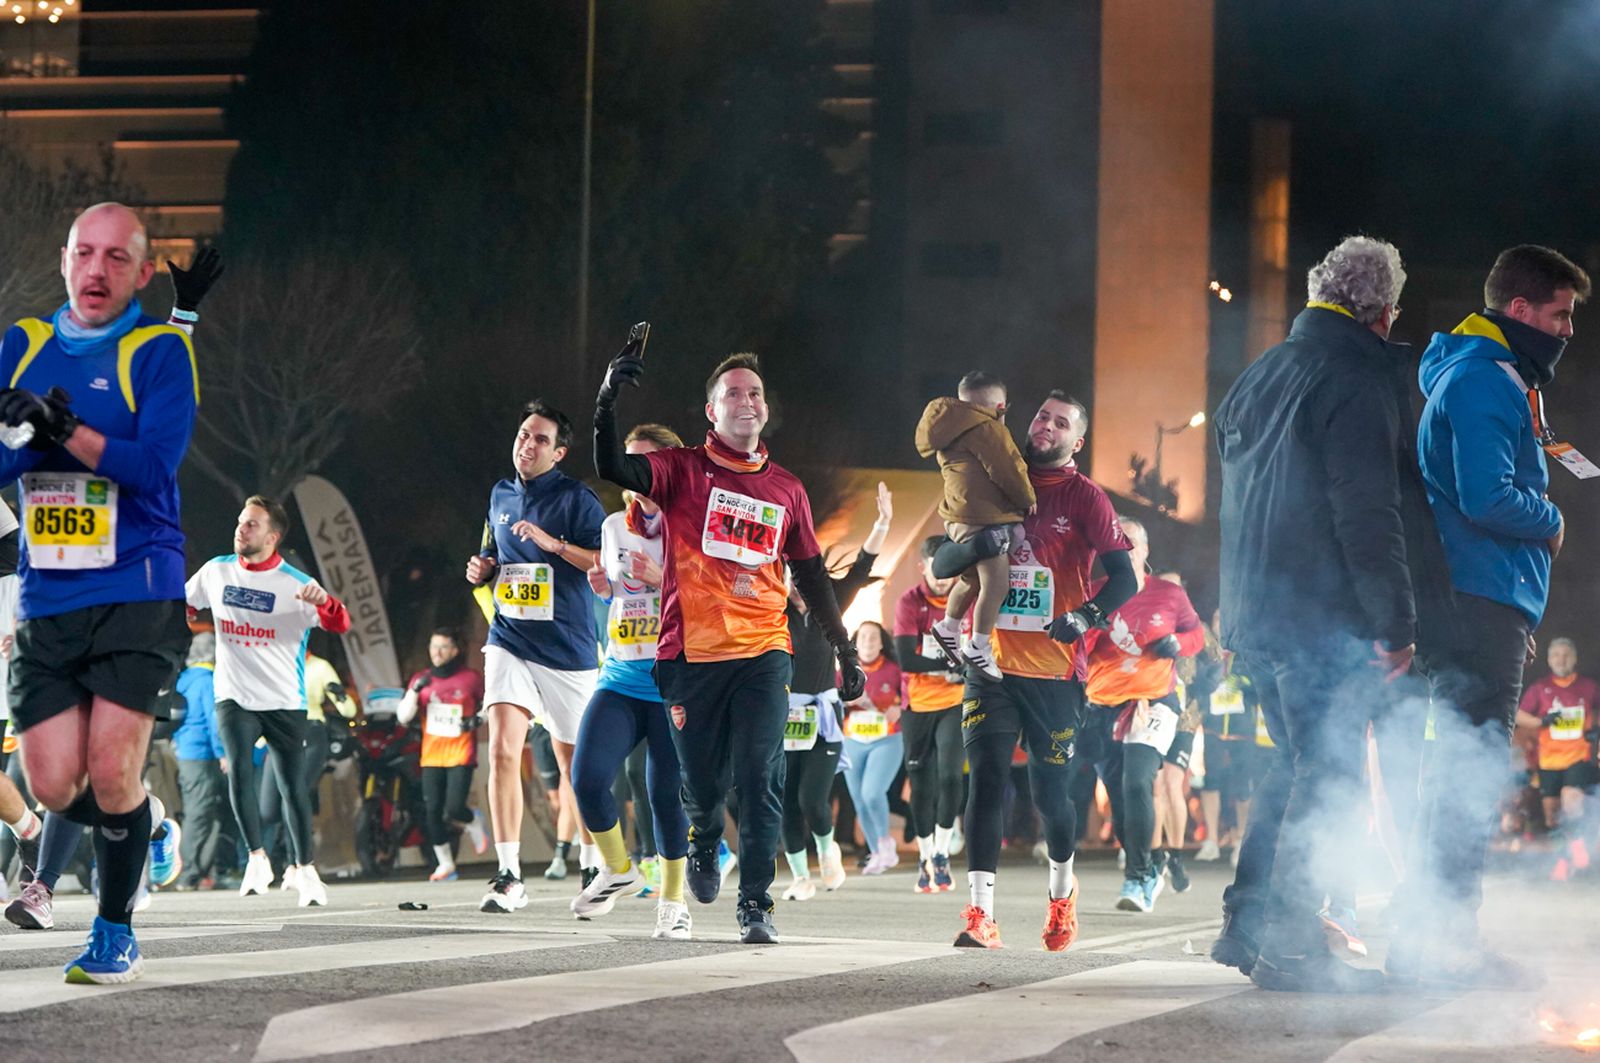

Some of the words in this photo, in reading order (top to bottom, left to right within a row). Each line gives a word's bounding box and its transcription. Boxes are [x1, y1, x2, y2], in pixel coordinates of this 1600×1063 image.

[35, 508, 95, 535] 8563
[722, 516, 765, 544] 9812
[333, 508, 388, 646] JAPEMASA
[505, 583, 540, 600] 339
[618, 617, 659, 638] 5722
